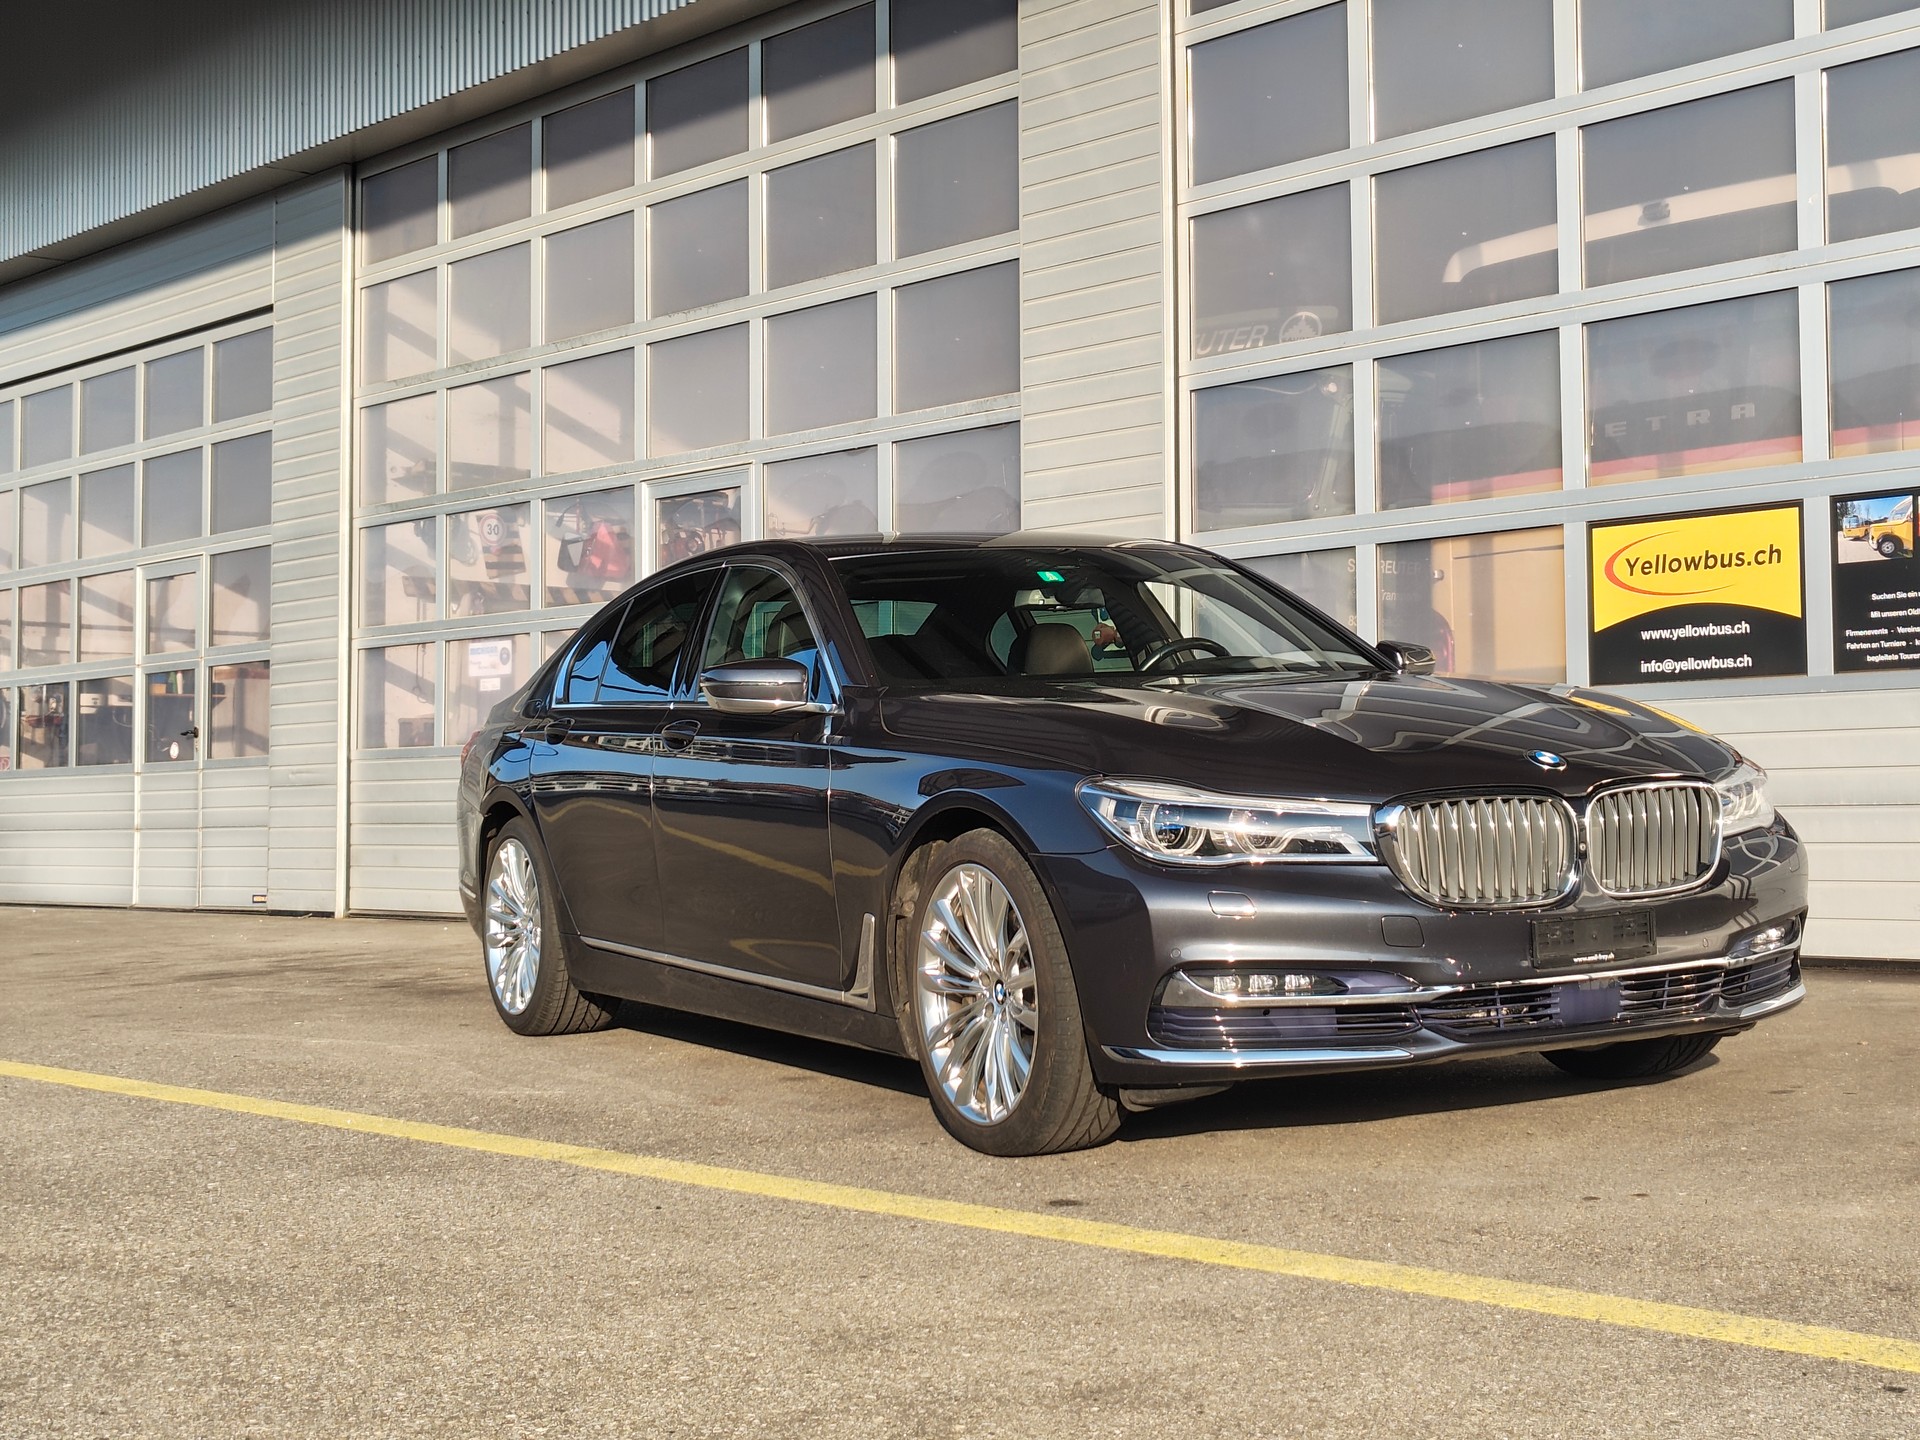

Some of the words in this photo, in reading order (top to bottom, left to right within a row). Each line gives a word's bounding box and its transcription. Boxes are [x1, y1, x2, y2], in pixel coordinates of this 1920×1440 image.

[1196, 324, 1269, 355] UTER
[487, 523, 500, 536] 30
[1625, 543, 1782, 577] Yellowbus.ch
[1871, 592, 1896, 601] Suchen
[1896, 591, 1907, 599] Sie
[1907, 590, 1918, 598] ein
[1870, 610, 1881, 618] Mit
[1881, 609, 1907, 617] unseren
[1641, 620, 1751, 641] www.yellowbus.ch
[1845, 627, 1888, 637] Firmenevents
[1846, 642, 1871, 650] Fahrten
[1641, 654, 1752, 674] info@yellowbus.ch
